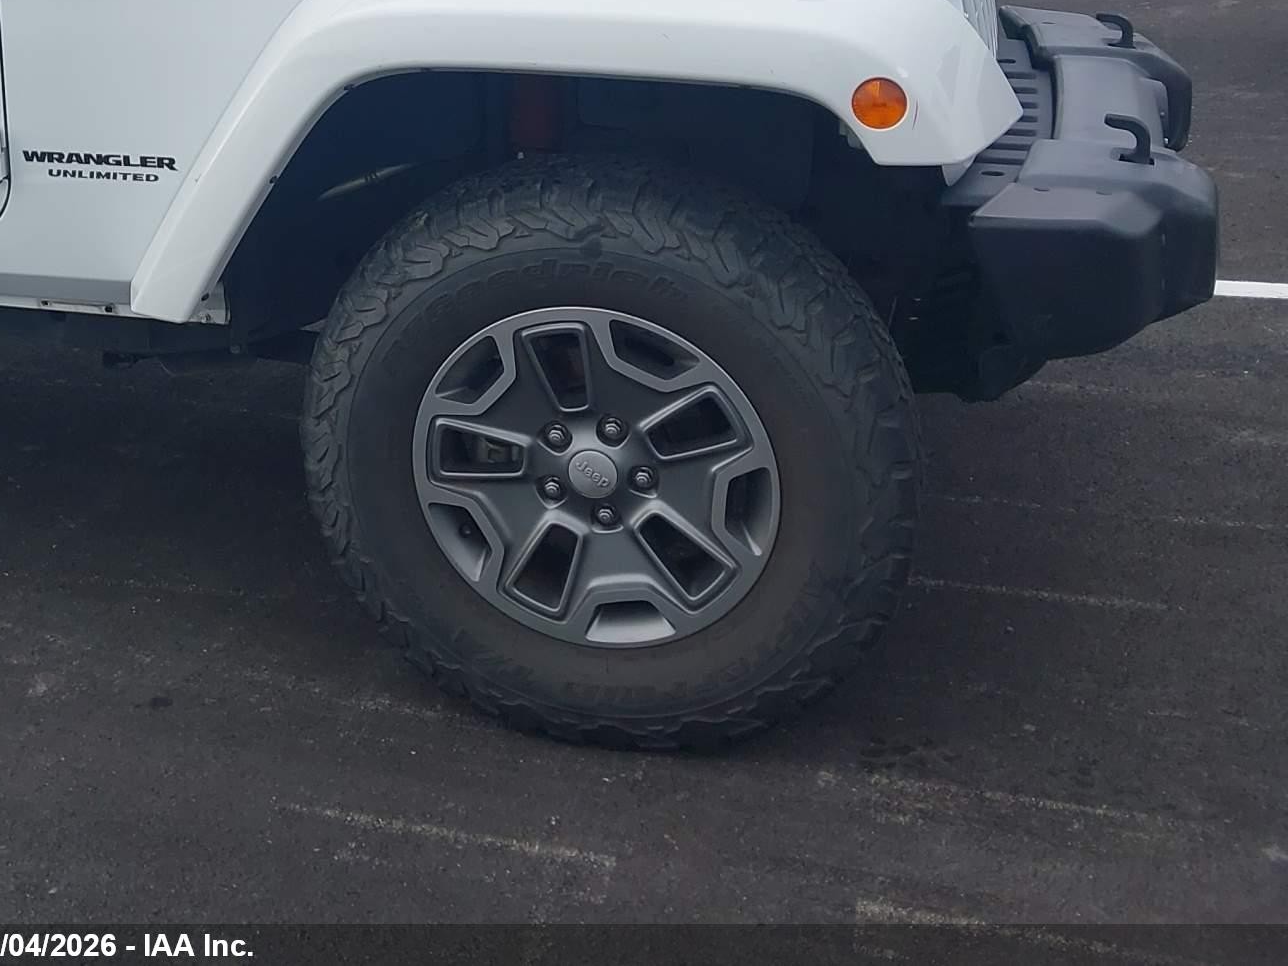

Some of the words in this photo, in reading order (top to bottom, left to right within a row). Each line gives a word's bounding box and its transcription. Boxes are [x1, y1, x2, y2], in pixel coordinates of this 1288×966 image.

[22, 150, 179, 171] WRANGLER
[48, 169, 159, 182] UNLIMITED
[575, 460, 610, 488] Jeep
